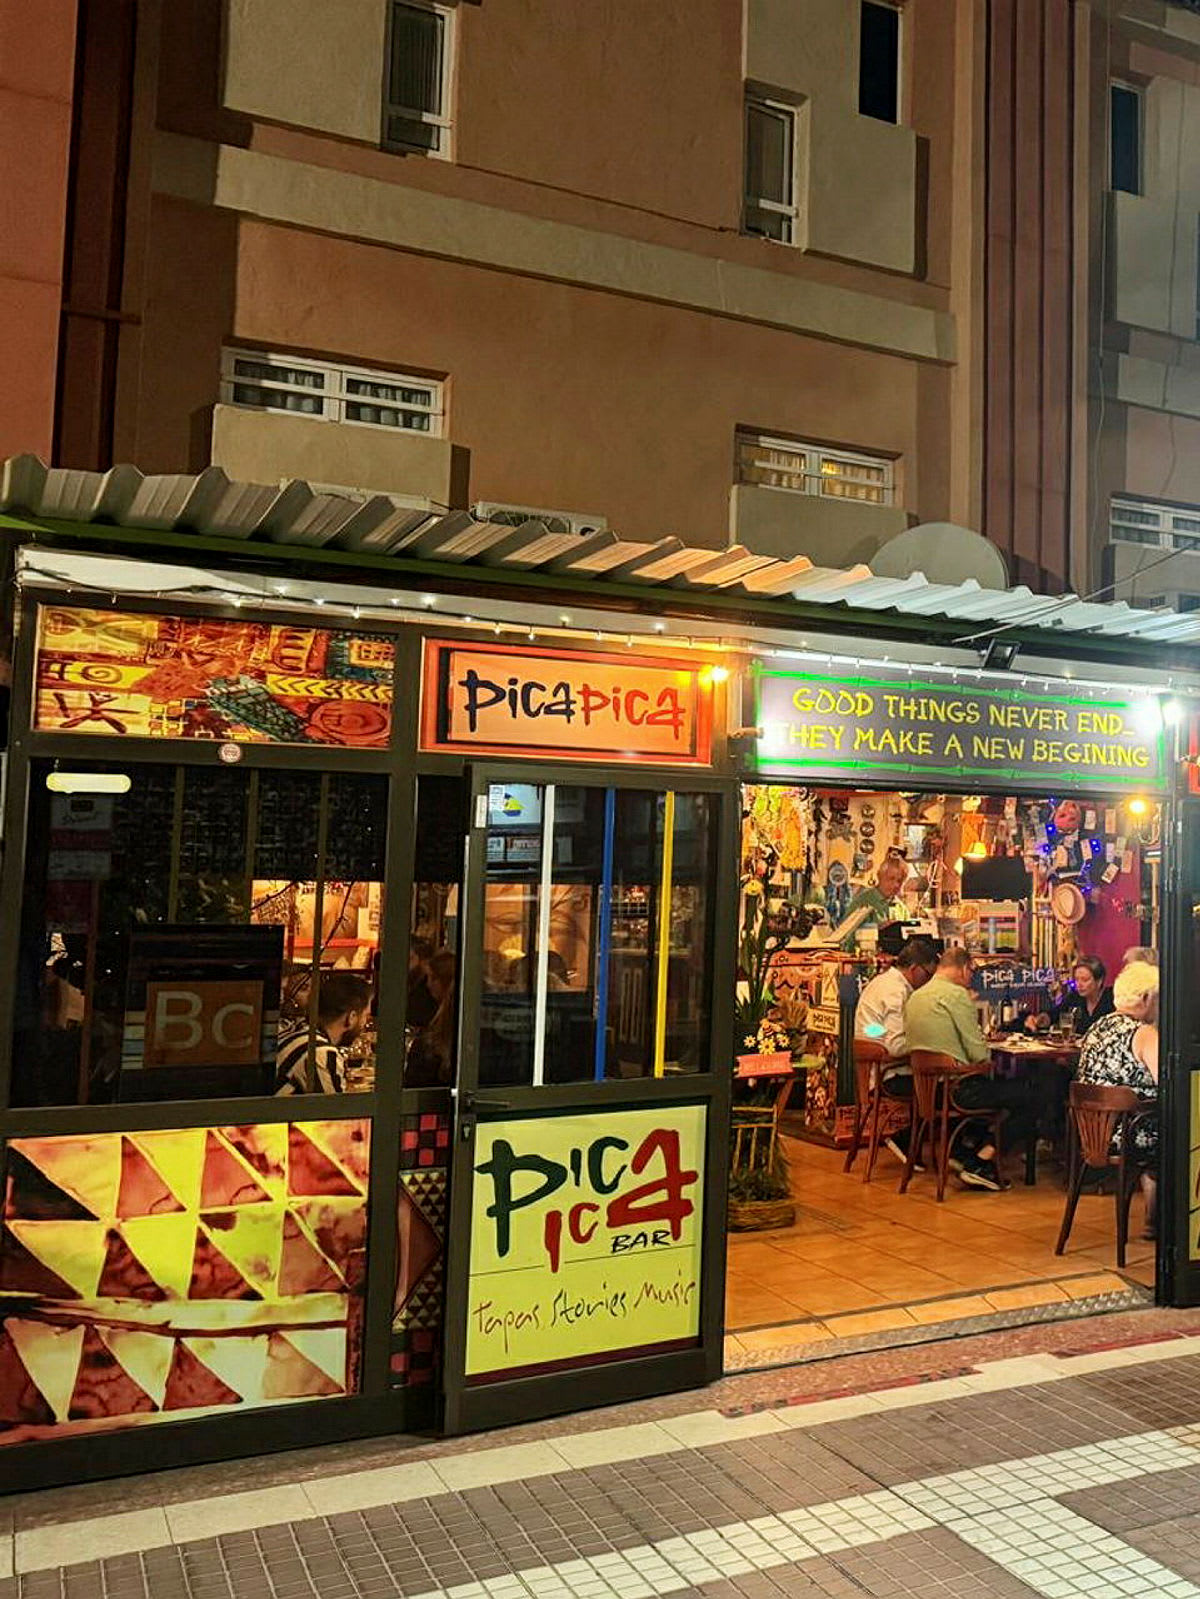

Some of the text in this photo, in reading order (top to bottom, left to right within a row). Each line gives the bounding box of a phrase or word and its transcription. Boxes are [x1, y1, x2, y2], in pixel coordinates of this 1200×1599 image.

[792, 688, 874, 718] GOOD
[883, 694, 981, 724] THINGS
[989, 705, 1068, 732] NEVER
[853, 727, 933, 756] MAKE
[944, 732, 963, 759] A
[973, 736, 1025, 762] NEW
[1032, 738, 1150, 769] BEGINING
[611, 1229, 672, 1254] BAR
